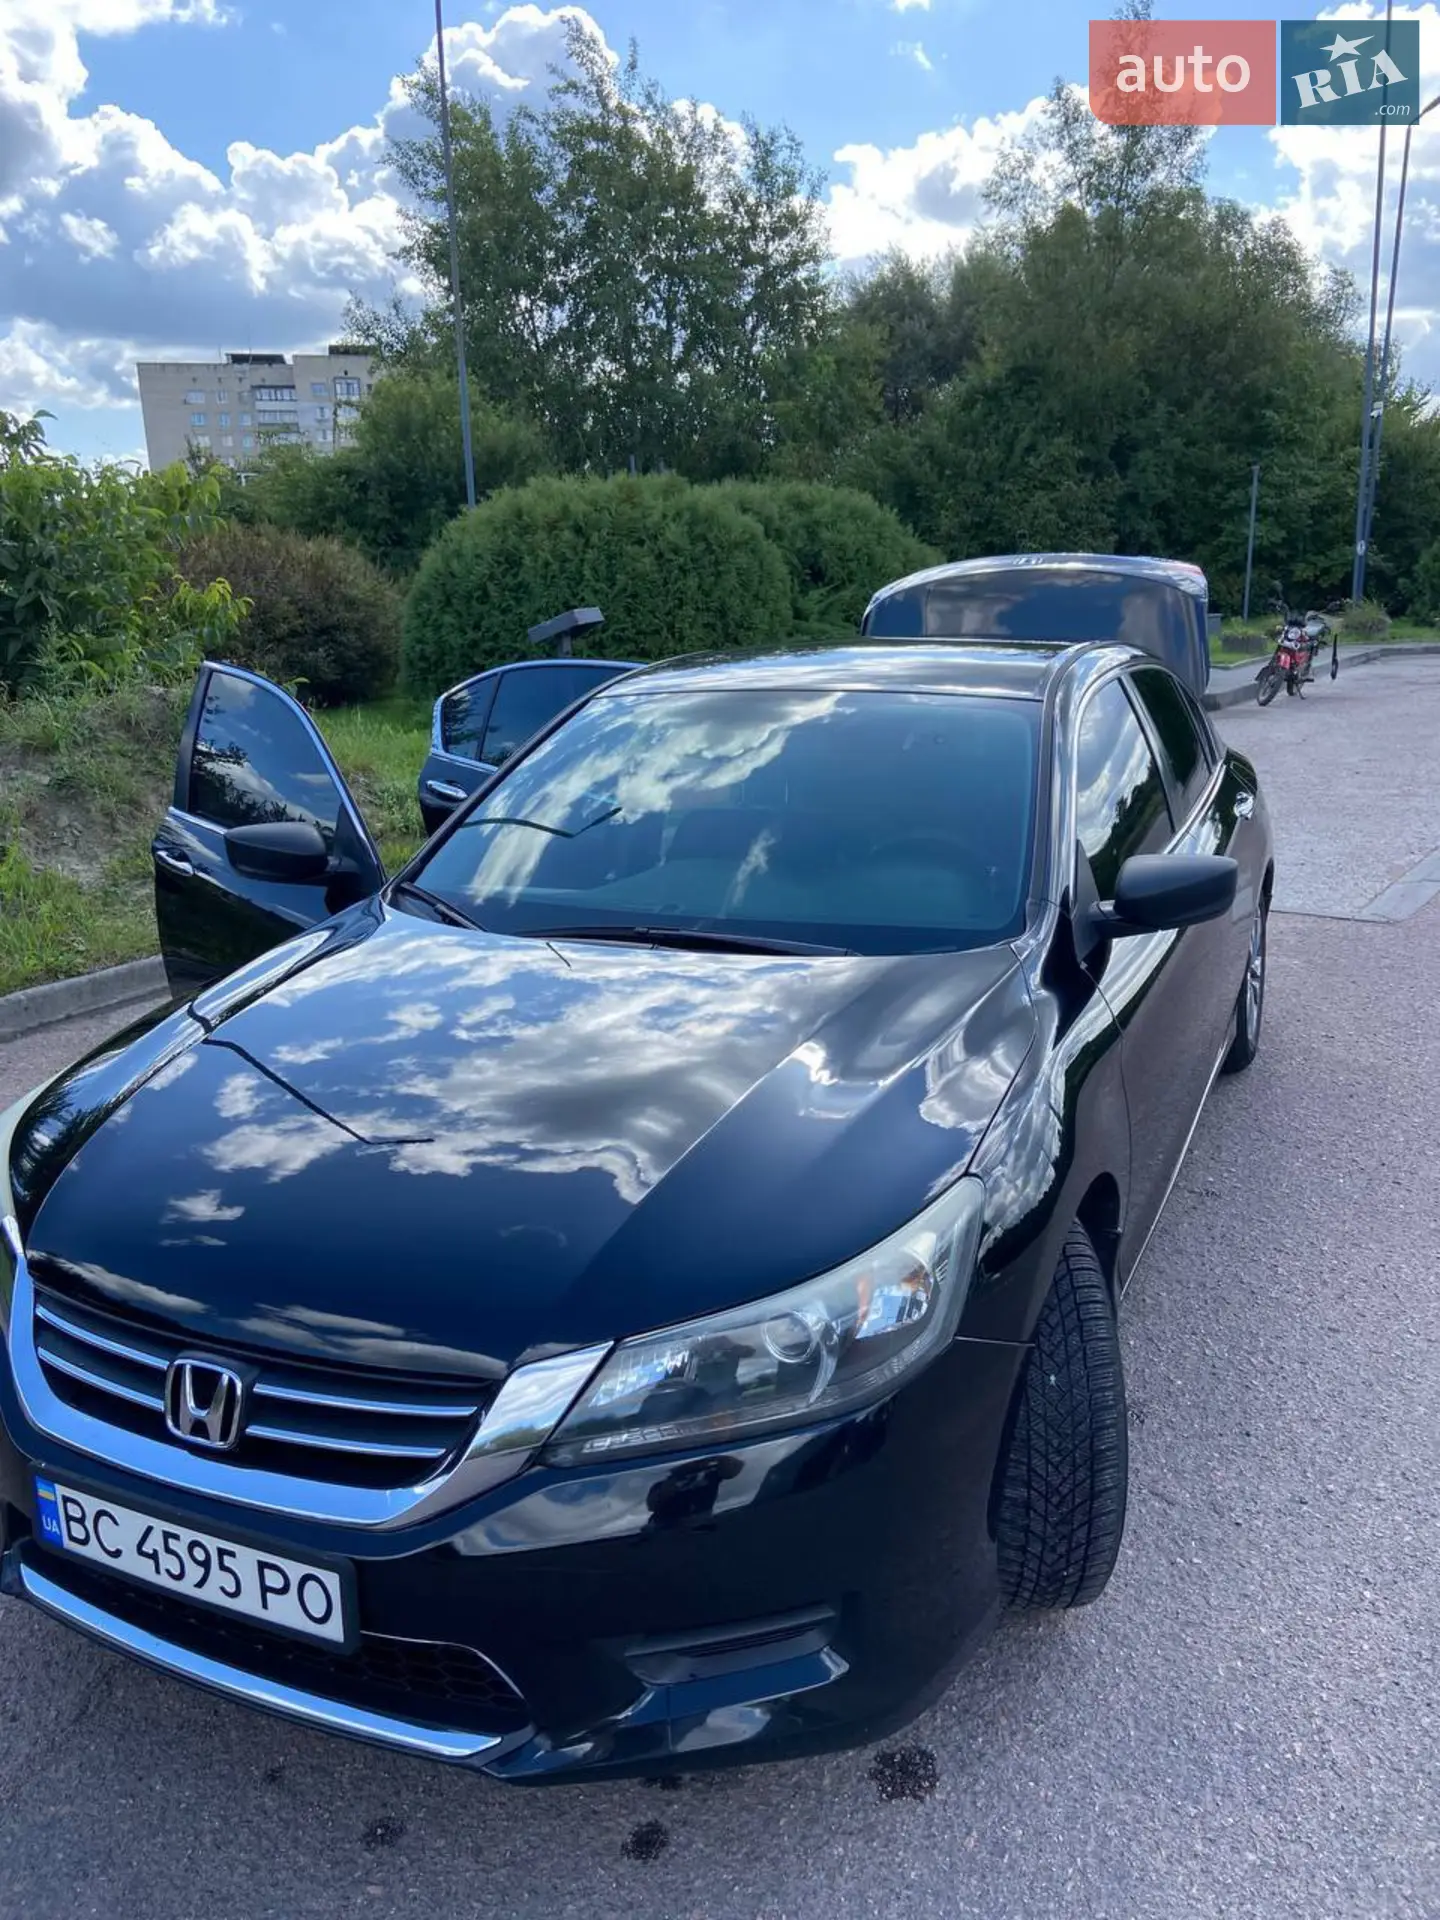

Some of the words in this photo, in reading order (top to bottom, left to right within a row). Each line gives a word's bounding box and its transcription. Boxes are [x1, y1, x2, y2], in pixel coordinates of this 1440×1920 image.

[42, 1518, 60, 1535] UA
[61, 1494, 123, 1559] BC
[136, 1524, 243, 1600] 4595
[256, 1559, 334, 1626] PO
